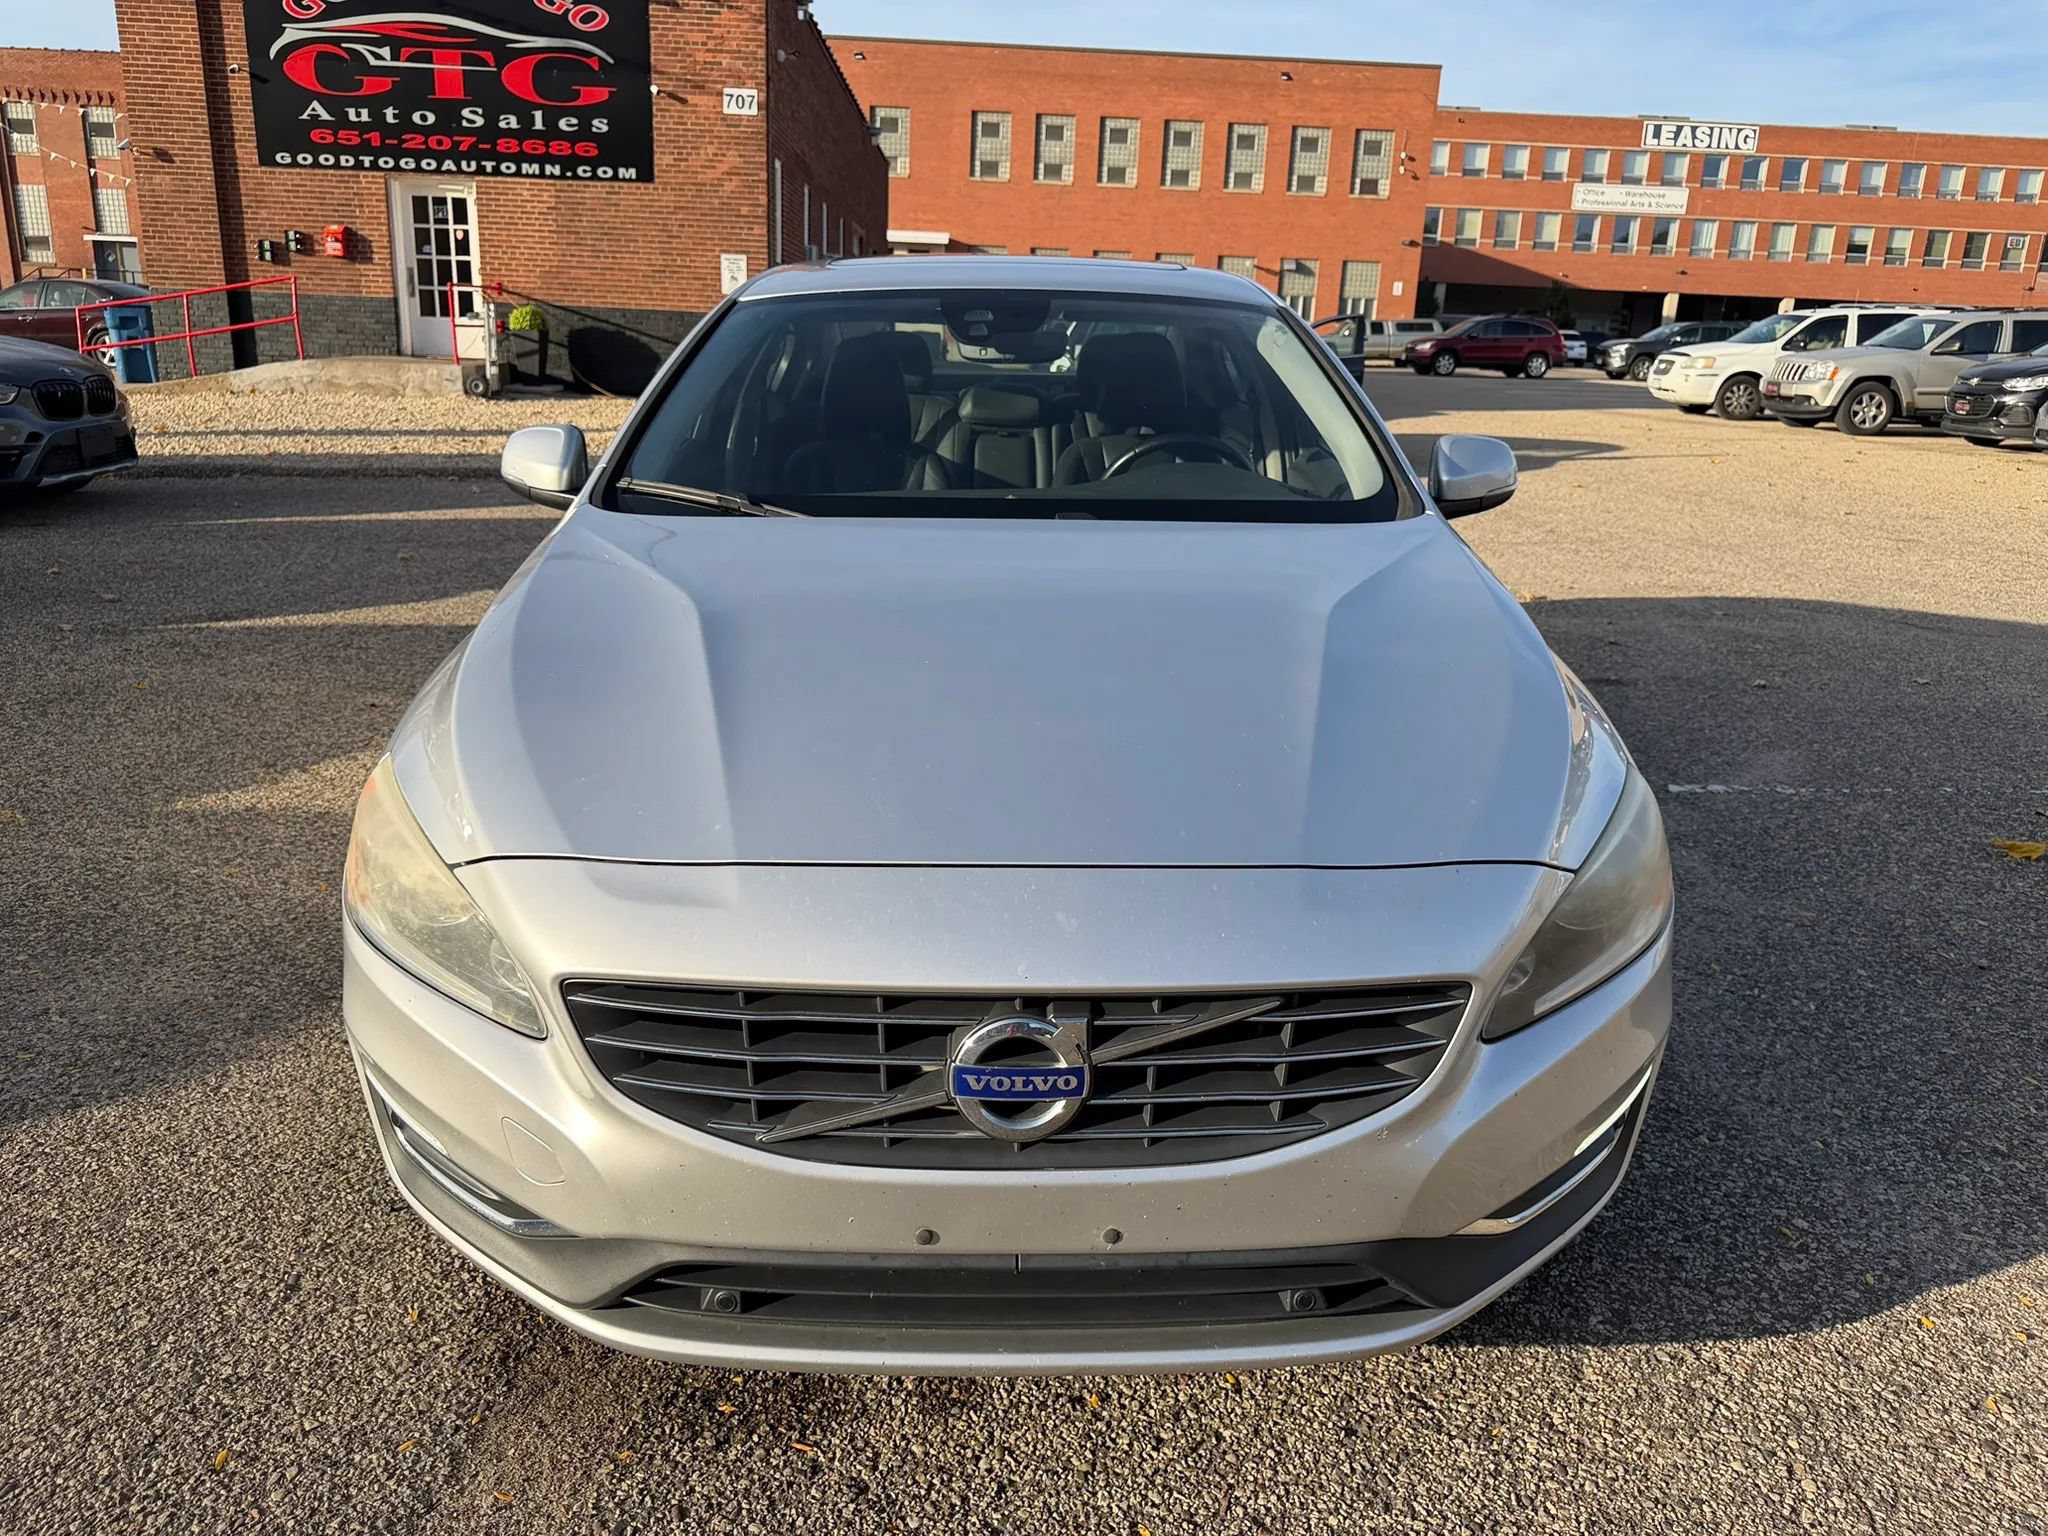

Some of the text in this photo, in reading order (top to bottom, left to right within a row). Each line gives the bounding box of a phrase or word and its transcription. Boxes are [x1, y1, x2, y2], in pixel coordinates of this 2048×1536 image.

[282, 43, 617, 106] GTG
[725, 93, 756, 110] 707
[298, 100, 610, 133] Auto Sales
[309, 127, 599, 157] 651-207-8686
[1645, 124, 1755, 150] LEASING
[274, 151, 637, 180] GOODTOGOAUTOMN.COM
[1581, 198, 1628, 207] Professional
[1655, 201, 1684, 209] Science
[1583, 188, 1666, 199] Office Warehouse
[962, 1074, 1078, 1092] VOLVO
